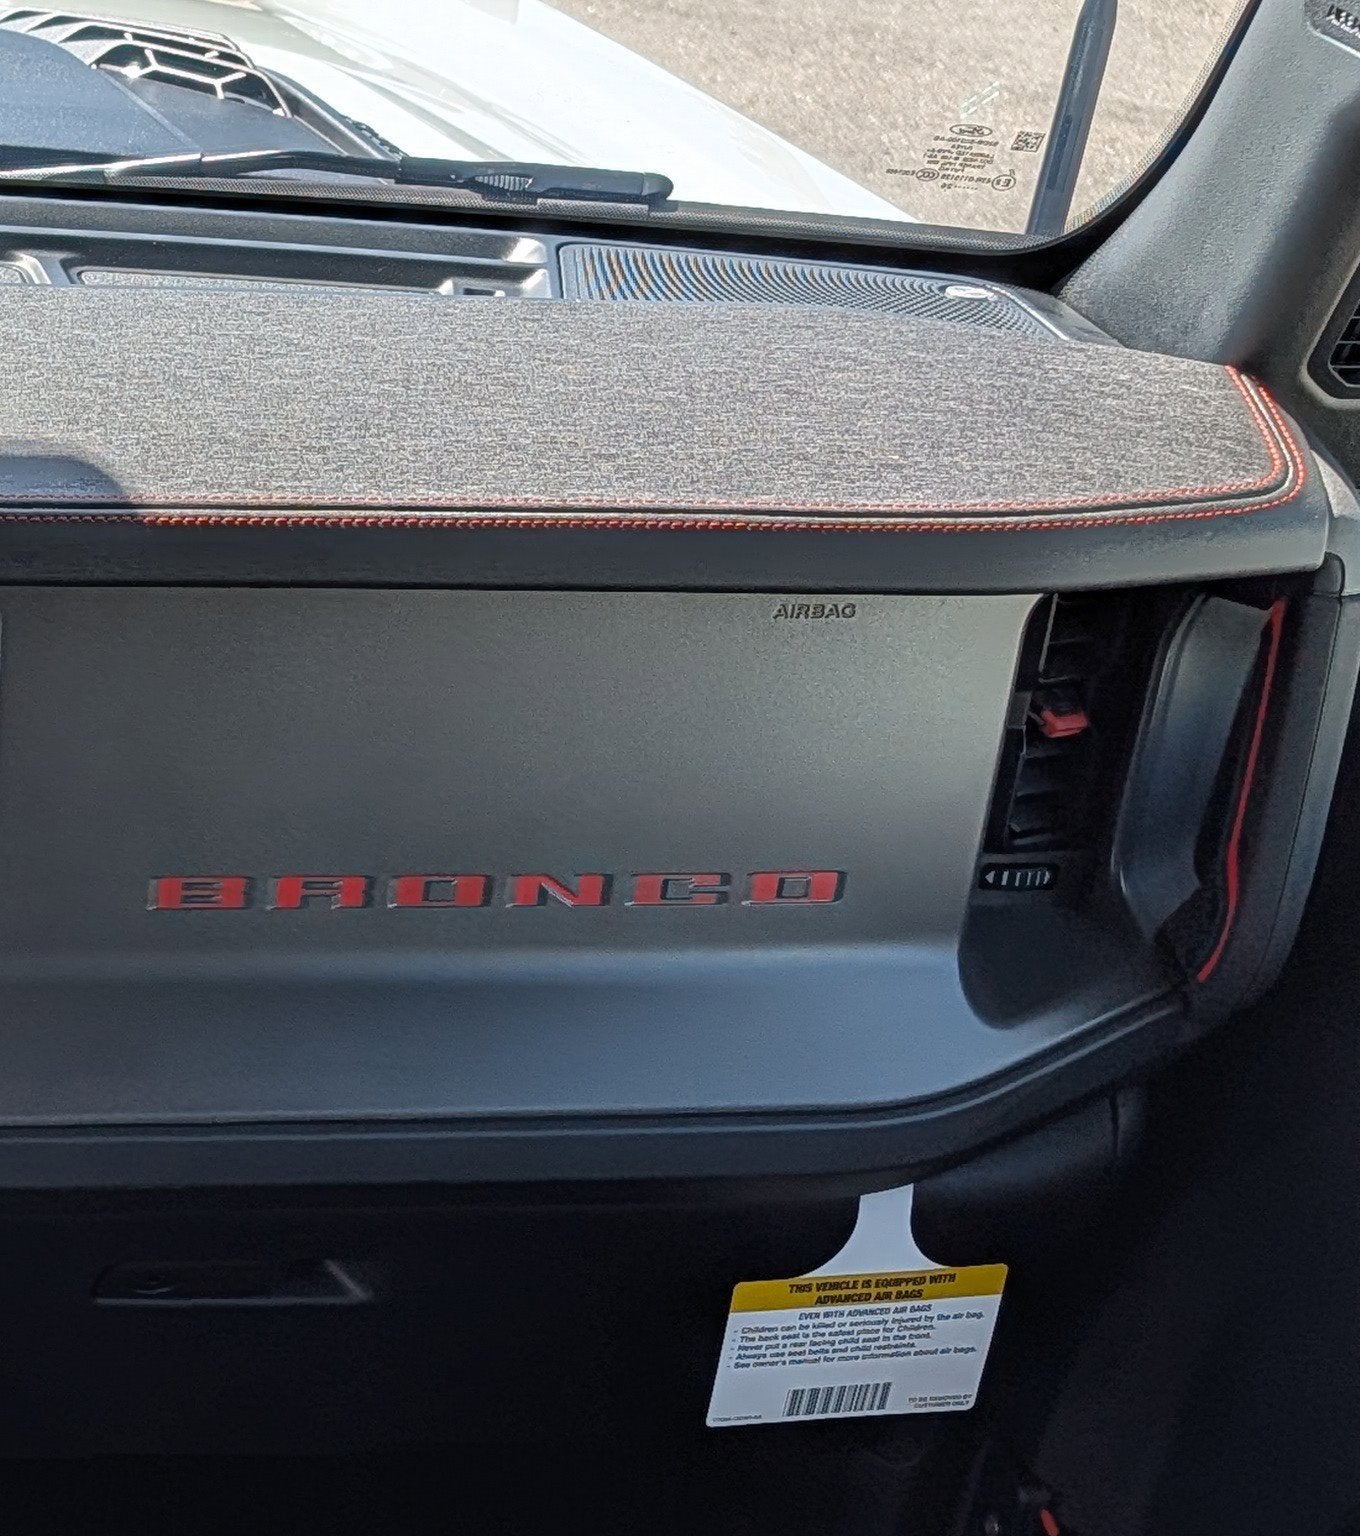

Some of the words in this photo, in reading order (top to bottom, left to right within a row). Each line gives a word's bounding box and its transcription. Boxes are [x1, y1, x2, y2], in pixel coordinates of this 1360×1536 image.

[772, 603, 856, 619] AIRBAG
[146, 872, 849, 910] BRONCO
[789, 1283, 813, 1293] THIS
[816, 1280, 859, 1292] VEHICLE
[861, 1279, 872, 1289] IS
[874, 1276, 926, 1288] EQUIPPED
[929, 1273, 956, 1284] WITH
[815, 1292, 872, 1305] ADVANCED
[874, 1291, 893, 1301] AIR
[895, 1289, 924, 1299] BAGS
[846, 1306, 891, 1317] ADVANCED
[892, 1306, 908, 1315] AIR
[909, 1304, 932, 1313] BAGS
